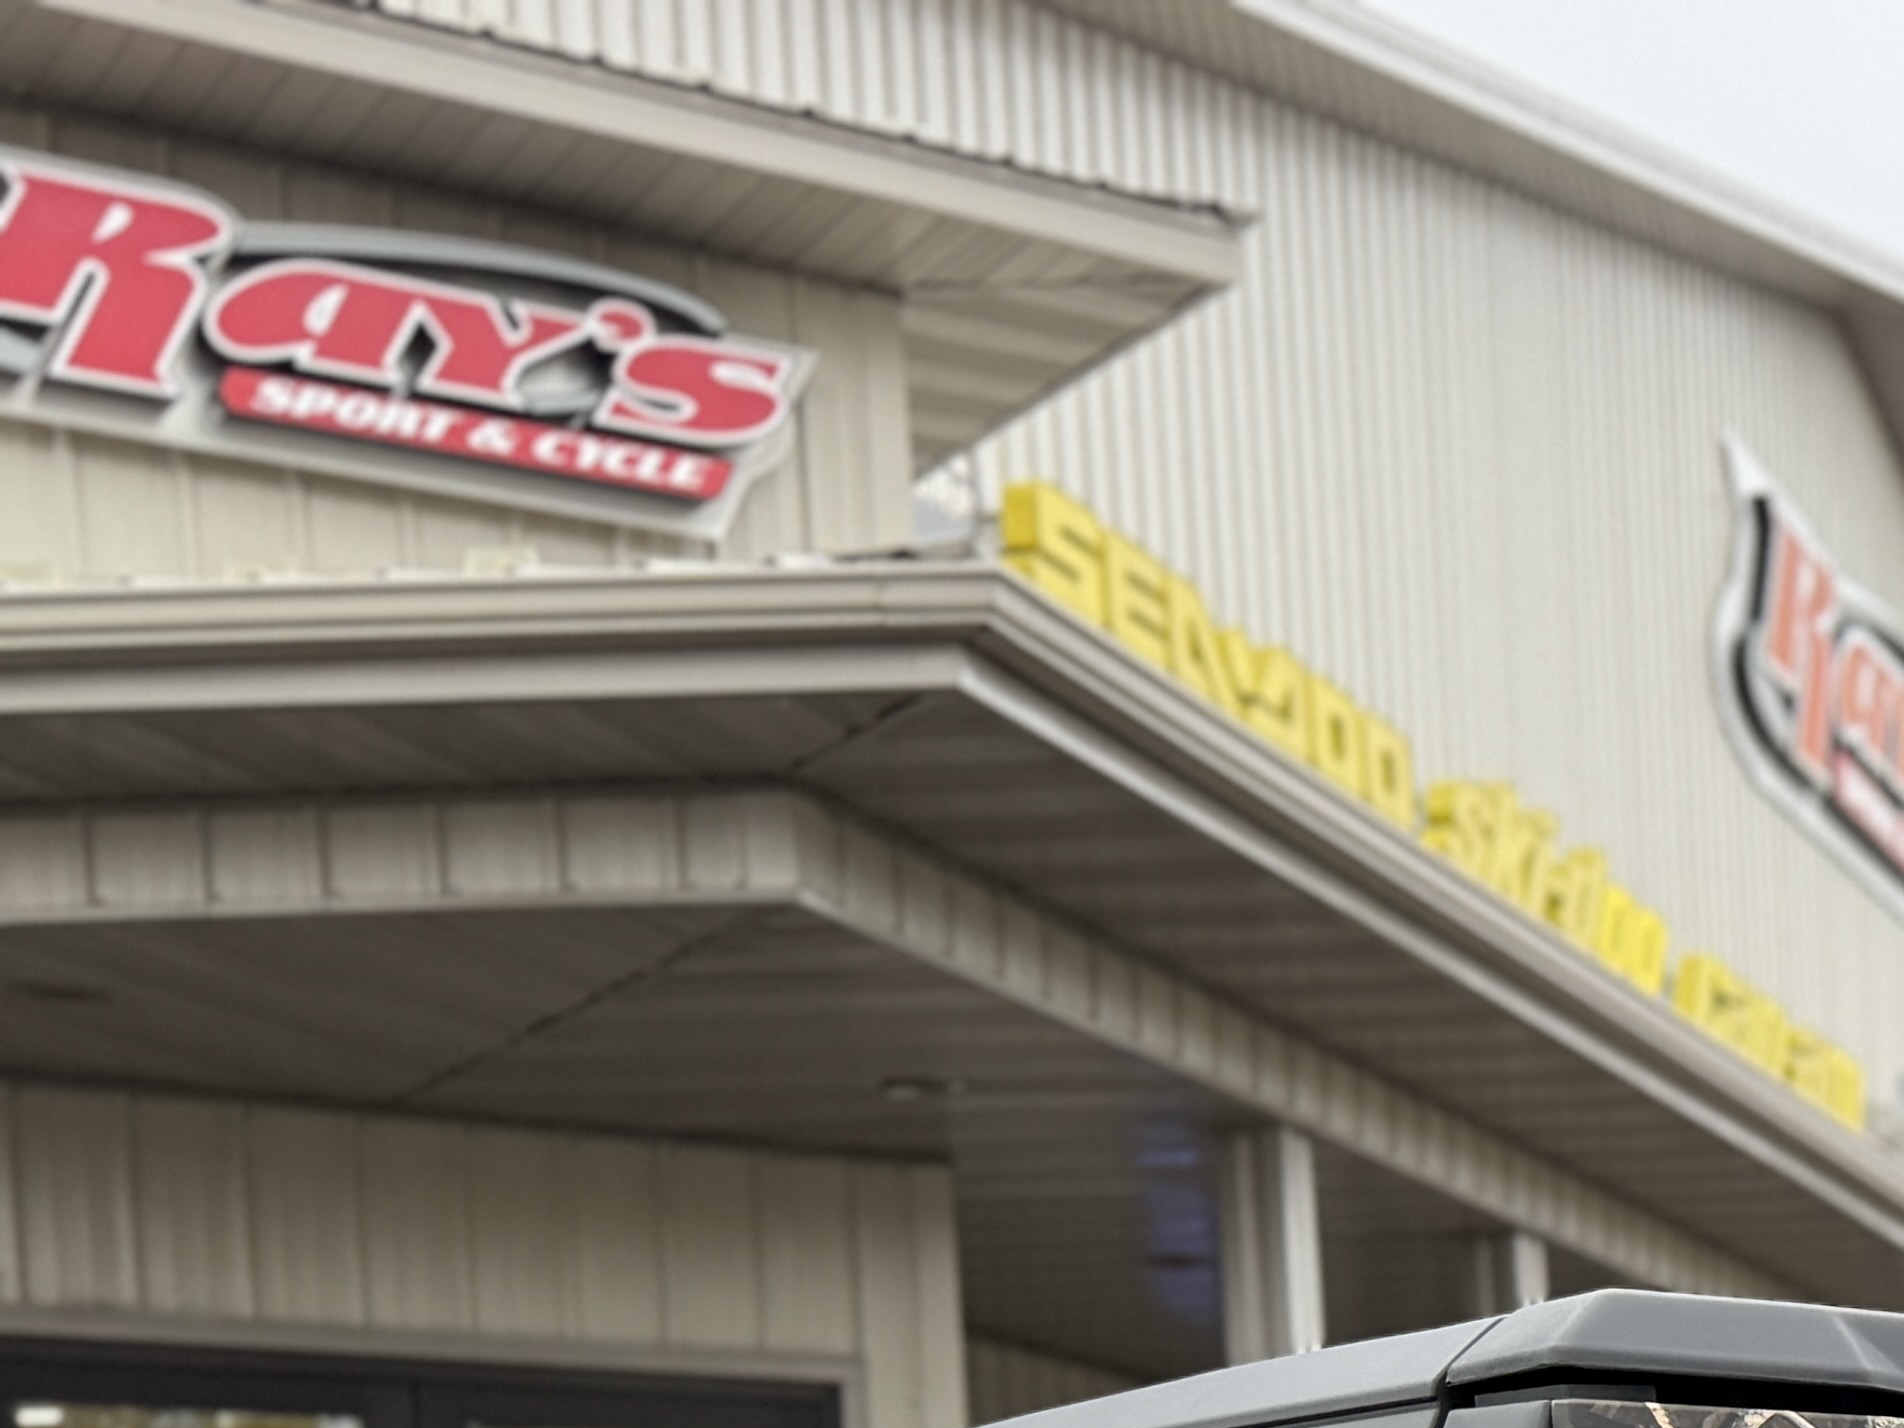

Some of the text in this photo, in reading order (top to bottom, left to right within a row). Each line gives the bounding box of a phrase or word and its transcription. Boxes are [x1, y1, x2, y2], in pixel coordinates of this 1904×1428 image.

[250, 374, 709, 493] SPORT & CYCLE
